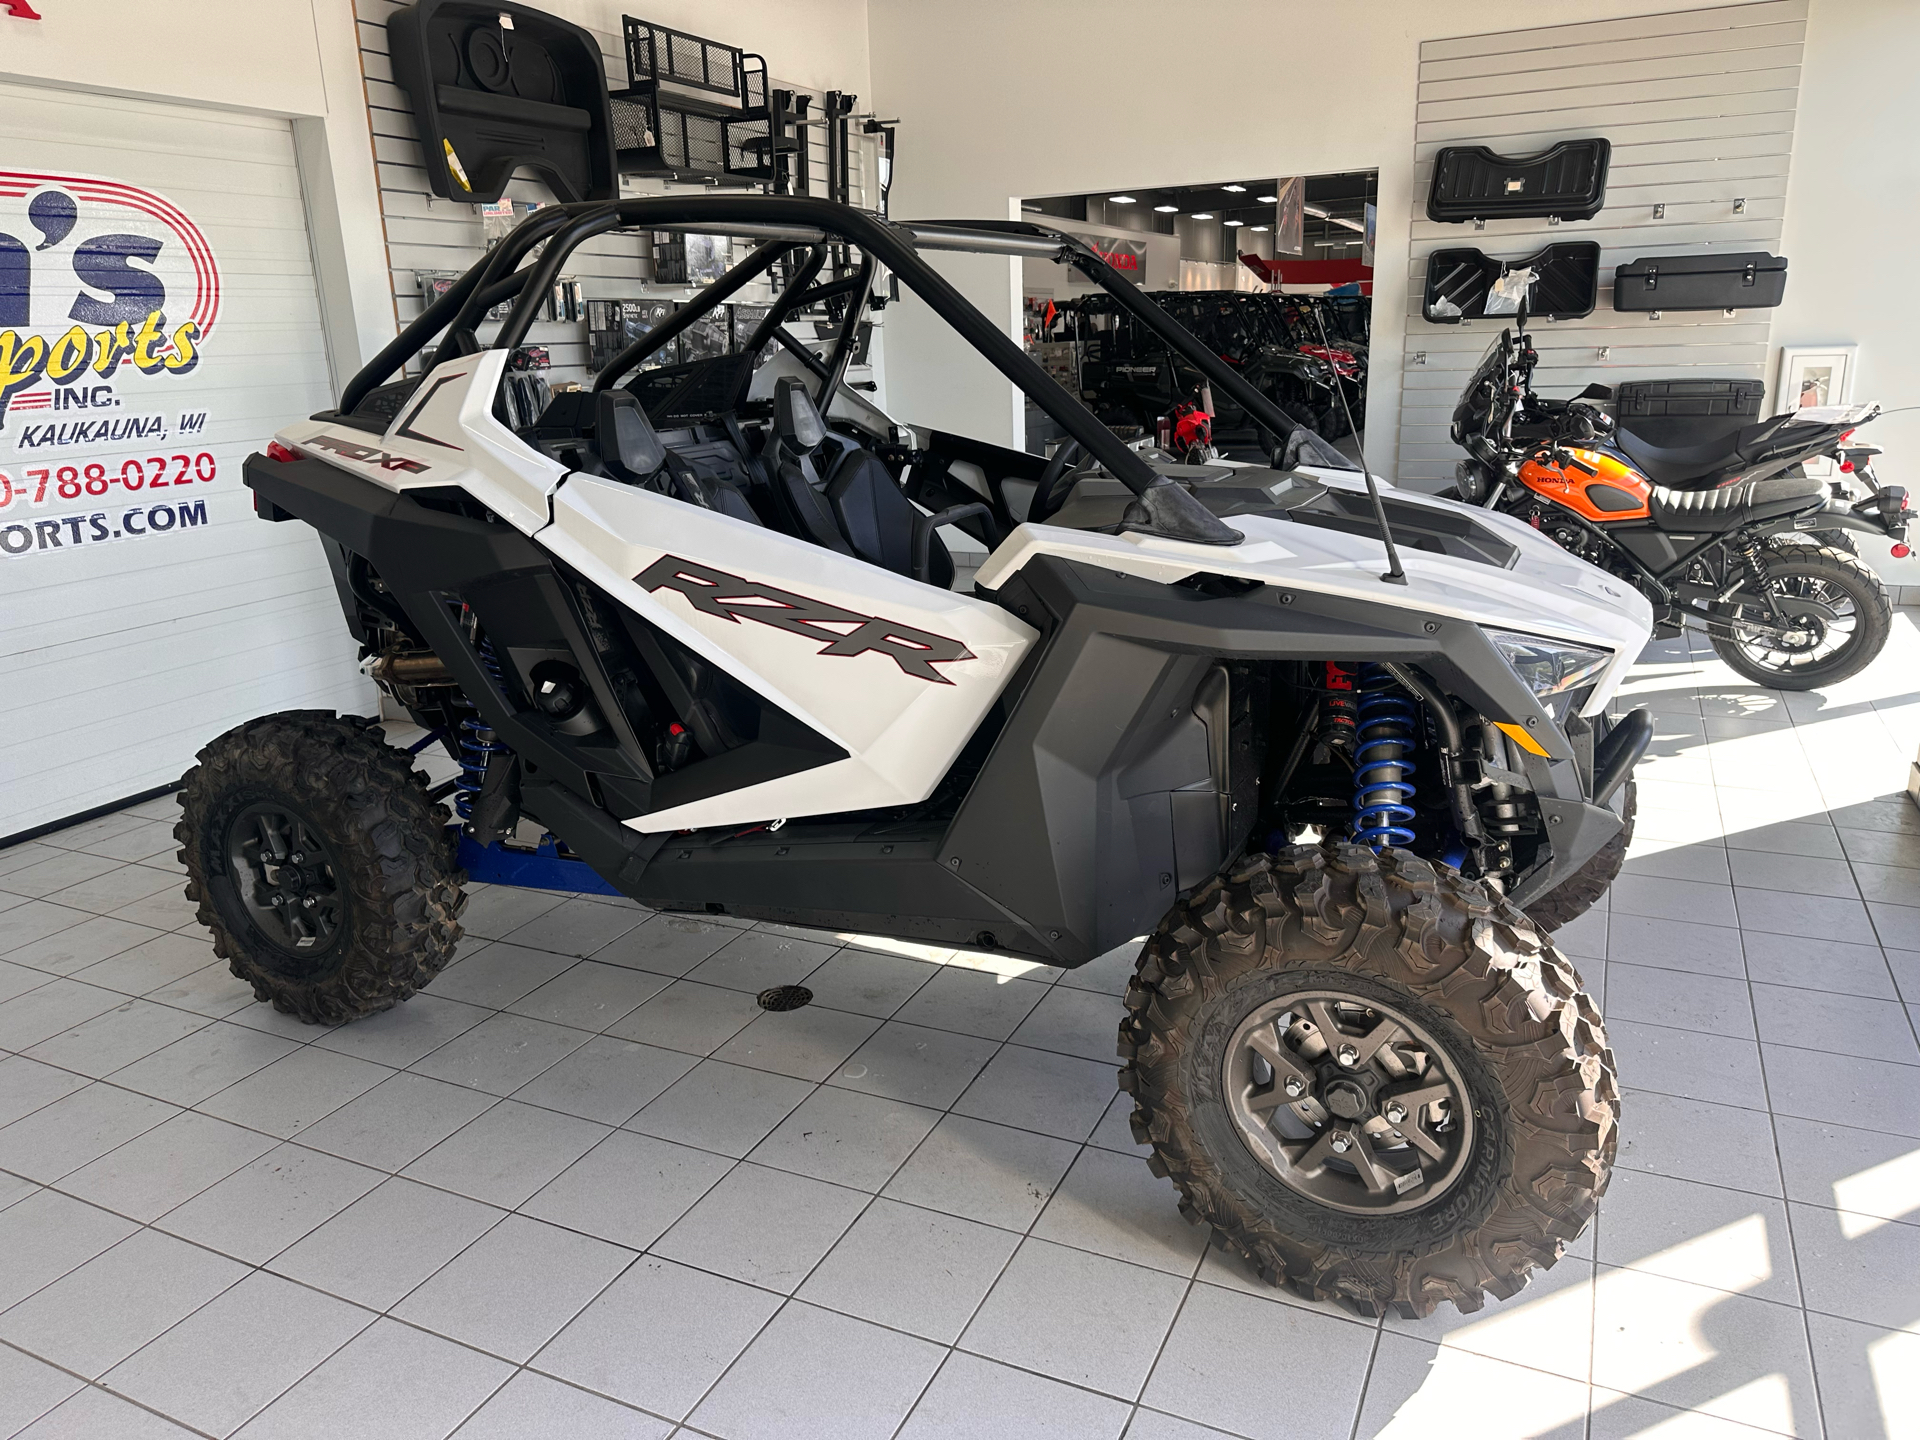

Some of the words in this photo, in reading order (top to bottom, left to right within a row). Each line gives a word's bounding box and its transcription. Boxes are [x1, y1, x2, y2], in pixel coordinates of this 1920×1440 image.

[53, 384, 121, 411] INC.
[18, 415, 169, 450] KAUKAUNA,
[179, 412, 207, 435] WI
[1536, 476, 1576, 485] HONDA
[631, 553, 979, 686] RZR
[1431, 1106, 1497, 1232] CARNIVORE
